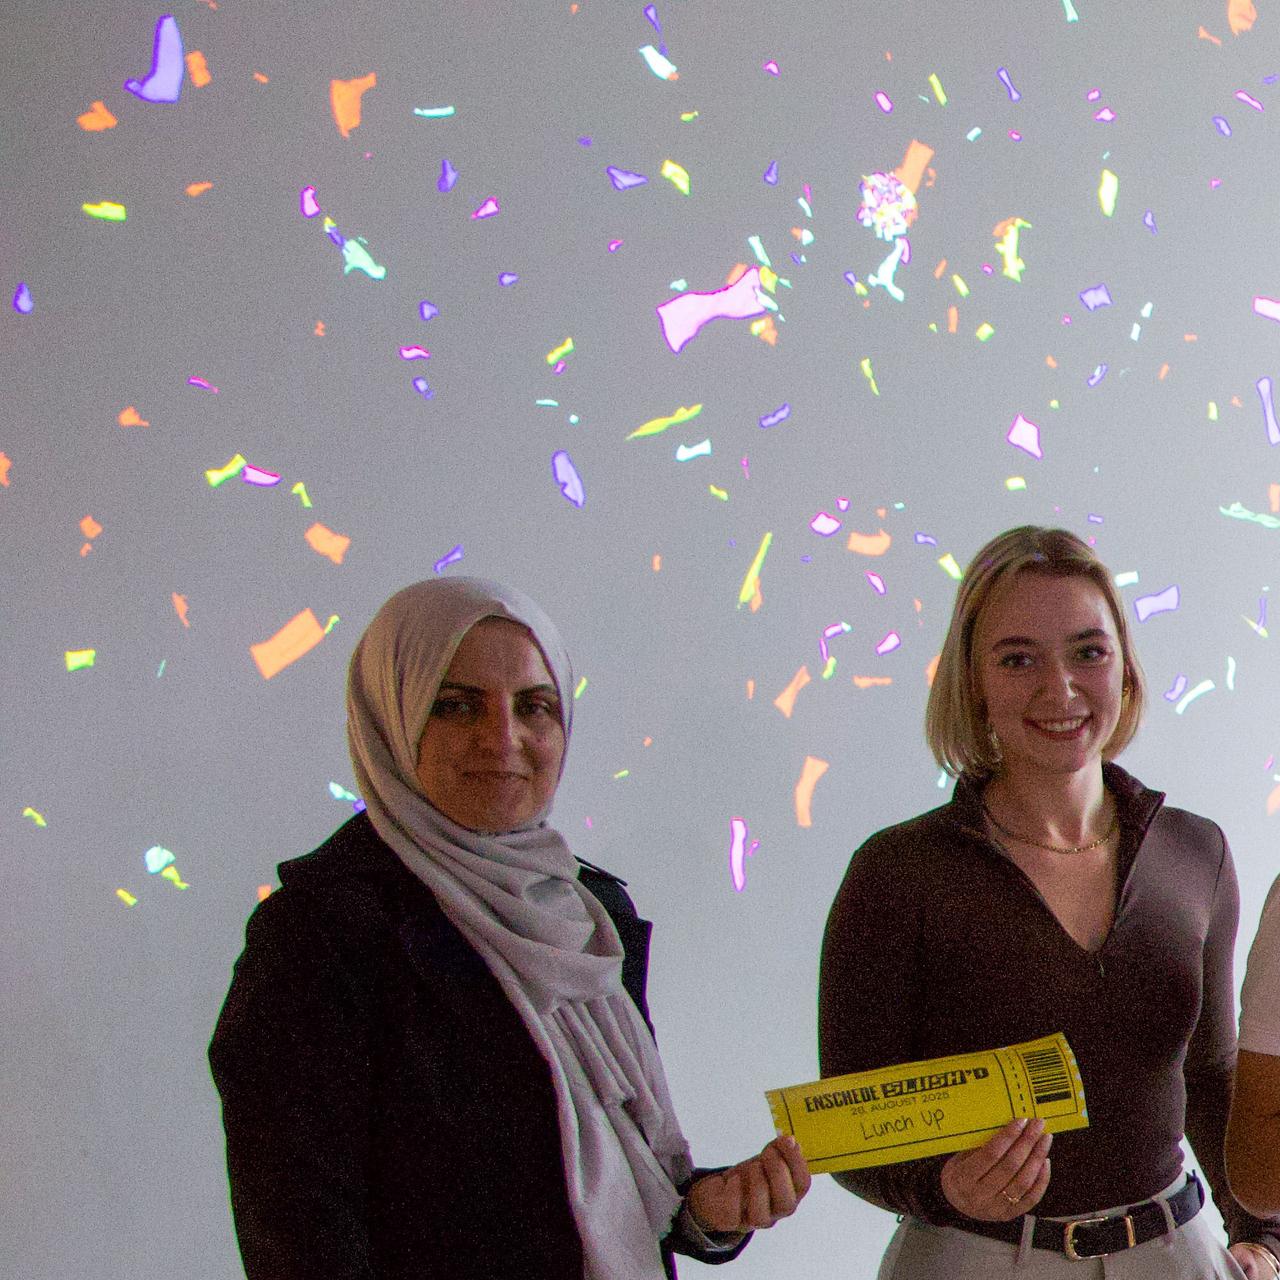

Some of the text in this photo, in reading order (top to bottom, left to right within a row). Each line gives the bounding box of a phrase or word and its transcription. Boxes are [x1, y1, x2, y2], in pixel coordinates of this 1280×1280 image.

[804, 1083, 880, 1113] ENSCHEDE
[870, 1096, 917, 1113] AUGUST
[860, 1107, 945, 1141] Lunch Up
